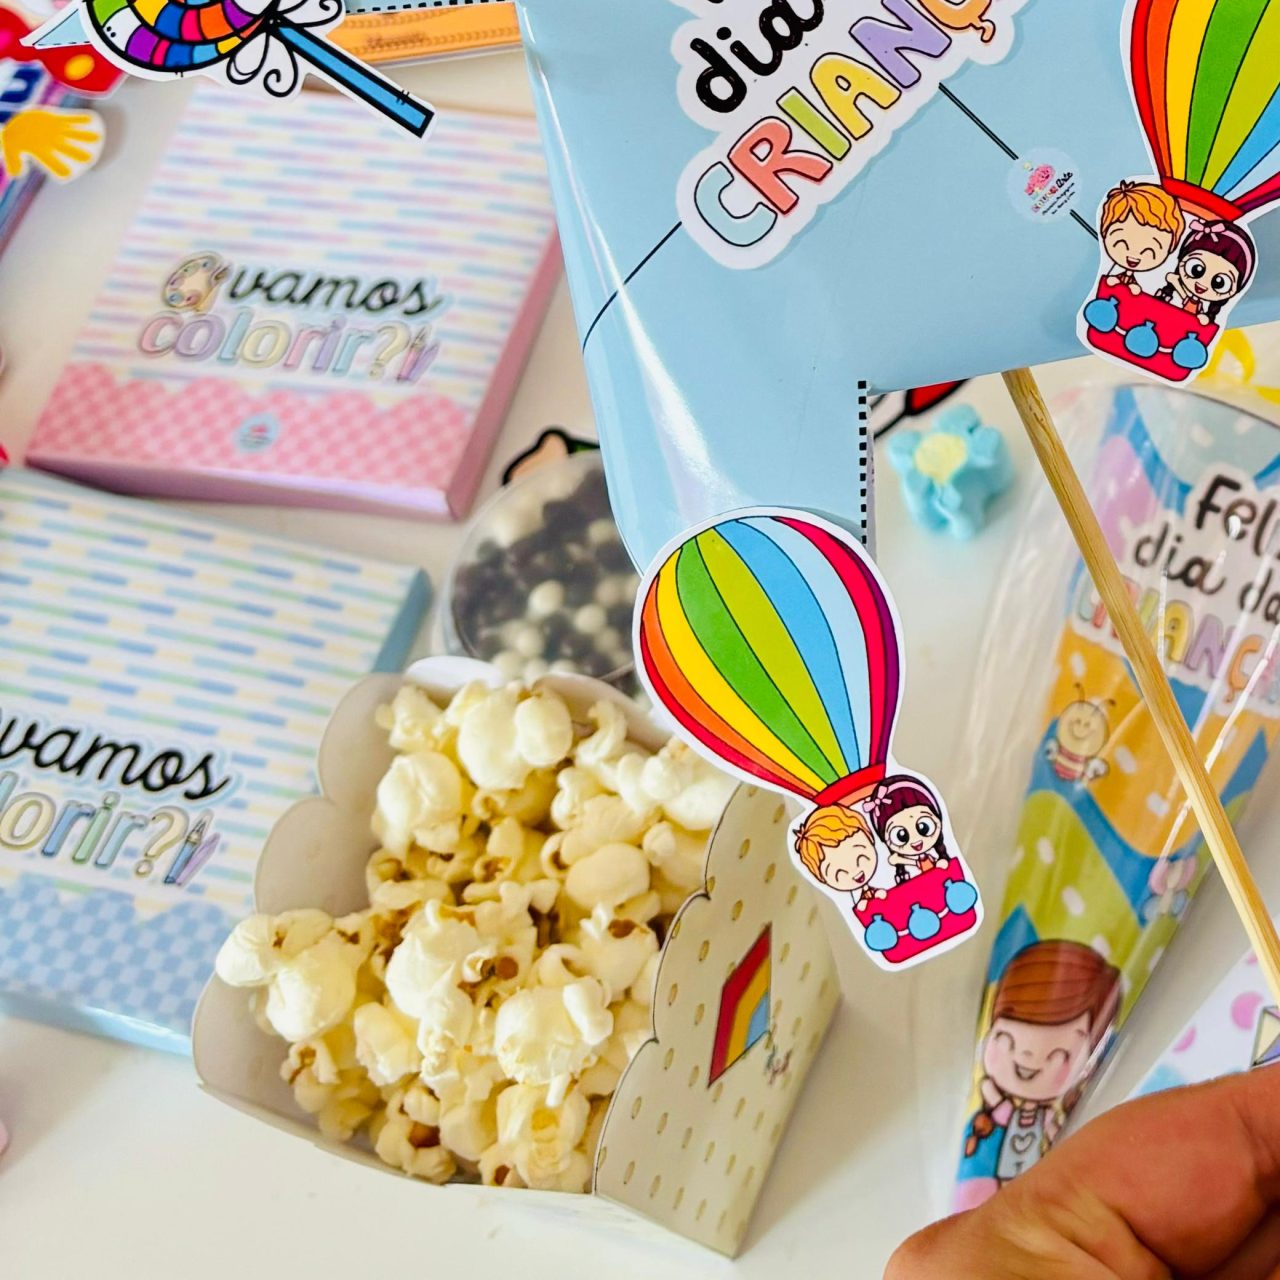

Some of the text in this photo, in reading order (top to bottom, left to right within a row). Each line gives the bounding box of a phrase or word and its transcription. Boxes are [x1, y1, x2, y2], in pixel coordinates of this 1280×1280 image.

[229, 266, 444, 316] vamos
[139, 308, 411, 379] colorir?
[1134, 521, 1227, 596] dia
